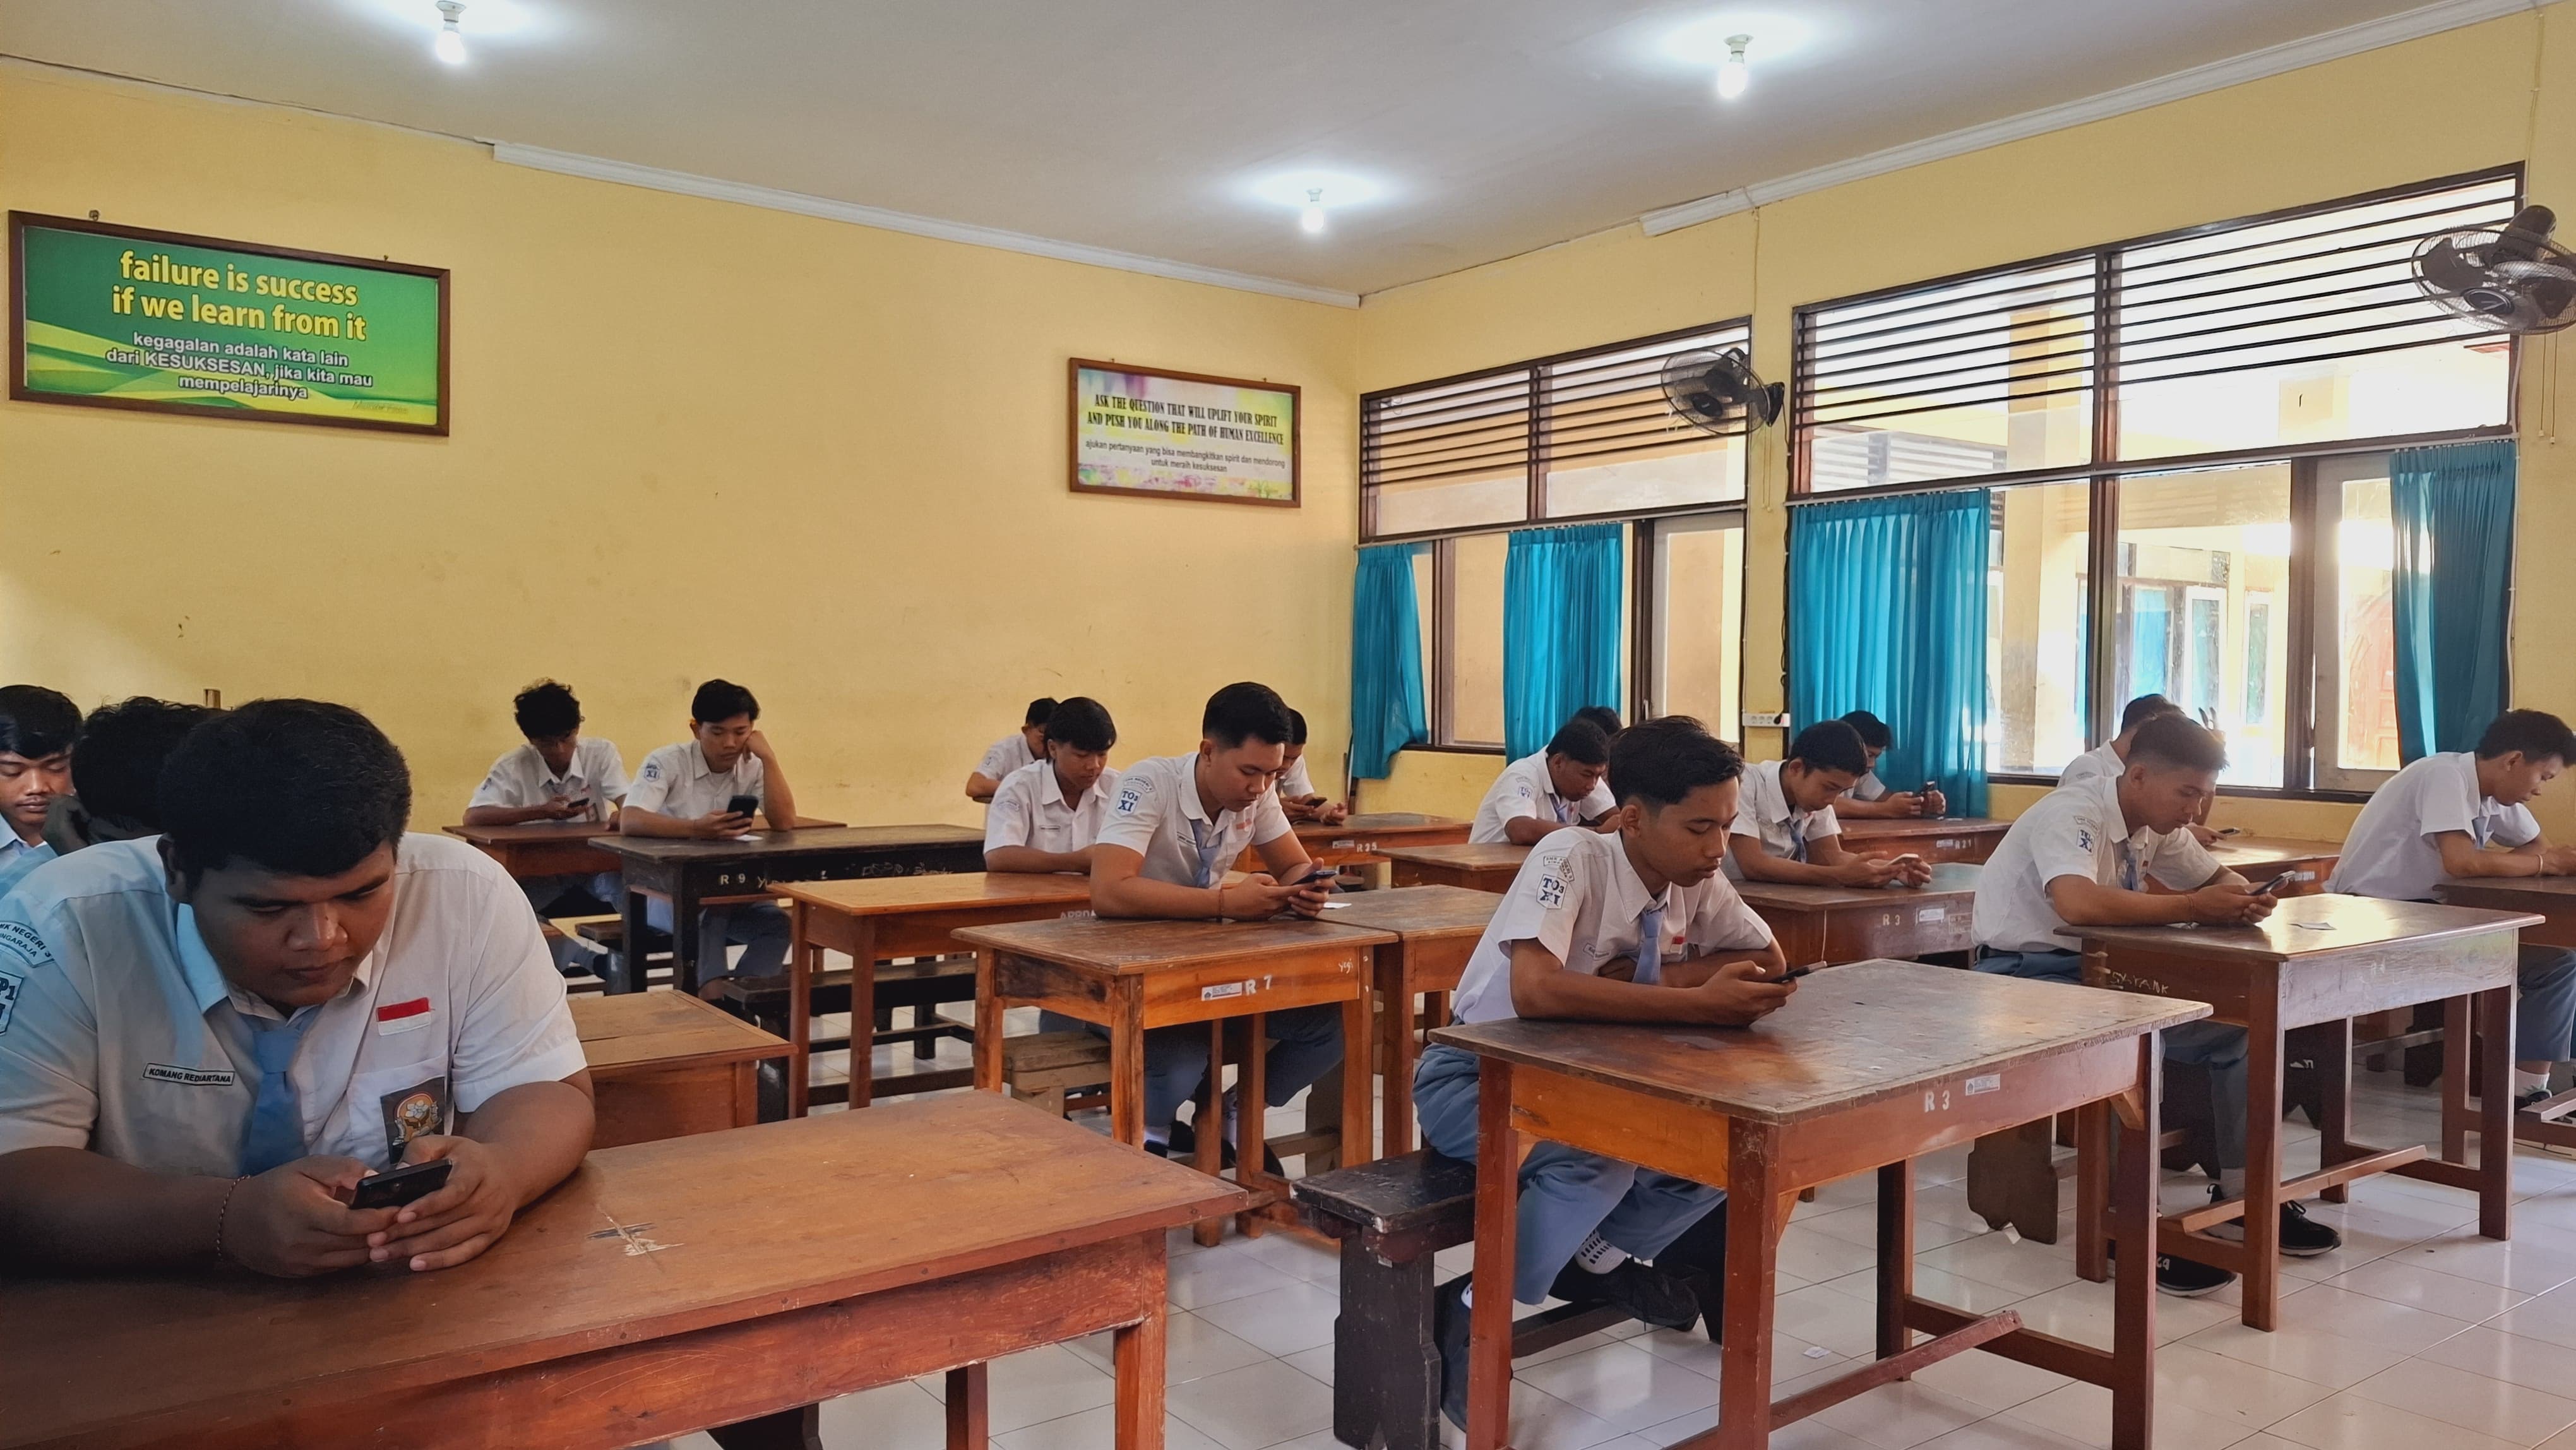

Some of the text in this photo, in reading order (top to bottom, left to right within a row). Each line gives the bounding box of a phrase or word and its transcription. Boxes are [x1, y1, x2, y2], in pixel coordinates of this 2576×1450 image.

[120, 250, 359, 306] failure is success
[112, 285, 366, 341] if we learn from it
[133, 331, 349, 367] kegagalan adalah kata lain
[106, 349, 373, 386] dari KESUKSESAN, jika kita mau
[179, 376, 308, 400] mempelajarinya
[1095, 394, 1277, 428] ASK THE QUESTION THAT WILL UPLIFT YOUR SPIRIT
[1087, 412, 1284, 445] AND PUSH YOU ALONG THE PATH OF HUMAN EXCELLENCE
[1086, 440, 1285, 469] ajukan pertanyaan yang bisa membangkitkan spirit dan mendorong
[1151, 458, 1227, 472] untuk meraih kesuksesan
[1118, 800, 1135, 812] XI
[1357, 843, 1363, 853] R
[720, 874, 729, 885] R
[738, 873, 746, 884] 9
[1883, 914, 1900, 926] R 3
[0, 932, 37, 958] INGARAJA
[11, 926, 47, 950] NEGERI
[1244, 980, 1257, 996] R
[1263, 975, 1272, 990] 7
[148, 1068, 232, 1082] KOMANG REDIARTANA
[1924, 1090, 1950, 1113] R 3
